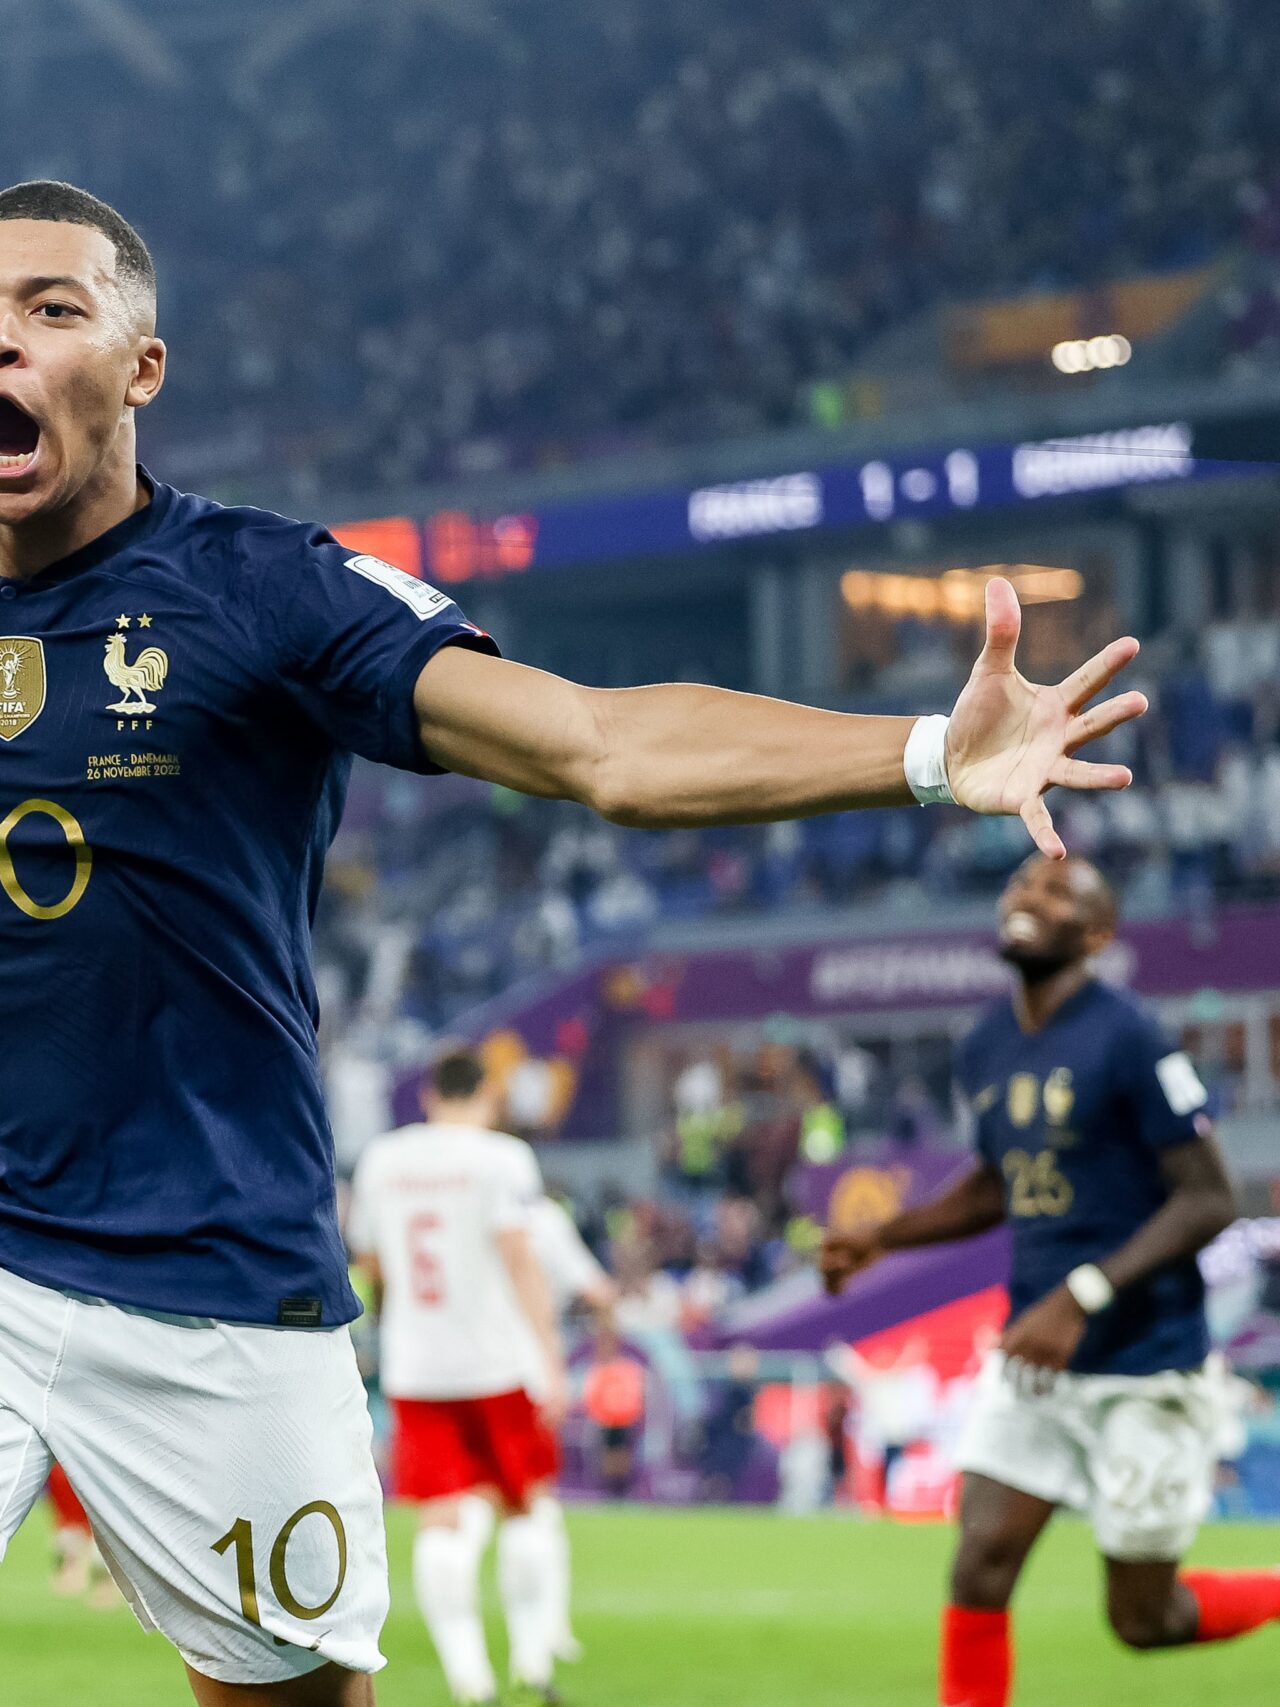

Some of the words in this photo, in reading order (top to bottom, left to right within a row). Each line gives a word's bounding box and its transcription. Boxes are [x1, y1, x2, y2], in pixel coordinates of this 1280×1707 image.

[88, 754, 121, 767] FRANCE
[130, 752, 179, 765] DANEMARK
[87, 768, 100, 779] 26
[103, 766, 151, 778] NOVEMBRE
[154, 764, 180, 776] 2022
[210, 1500, 347, 1626] 10
